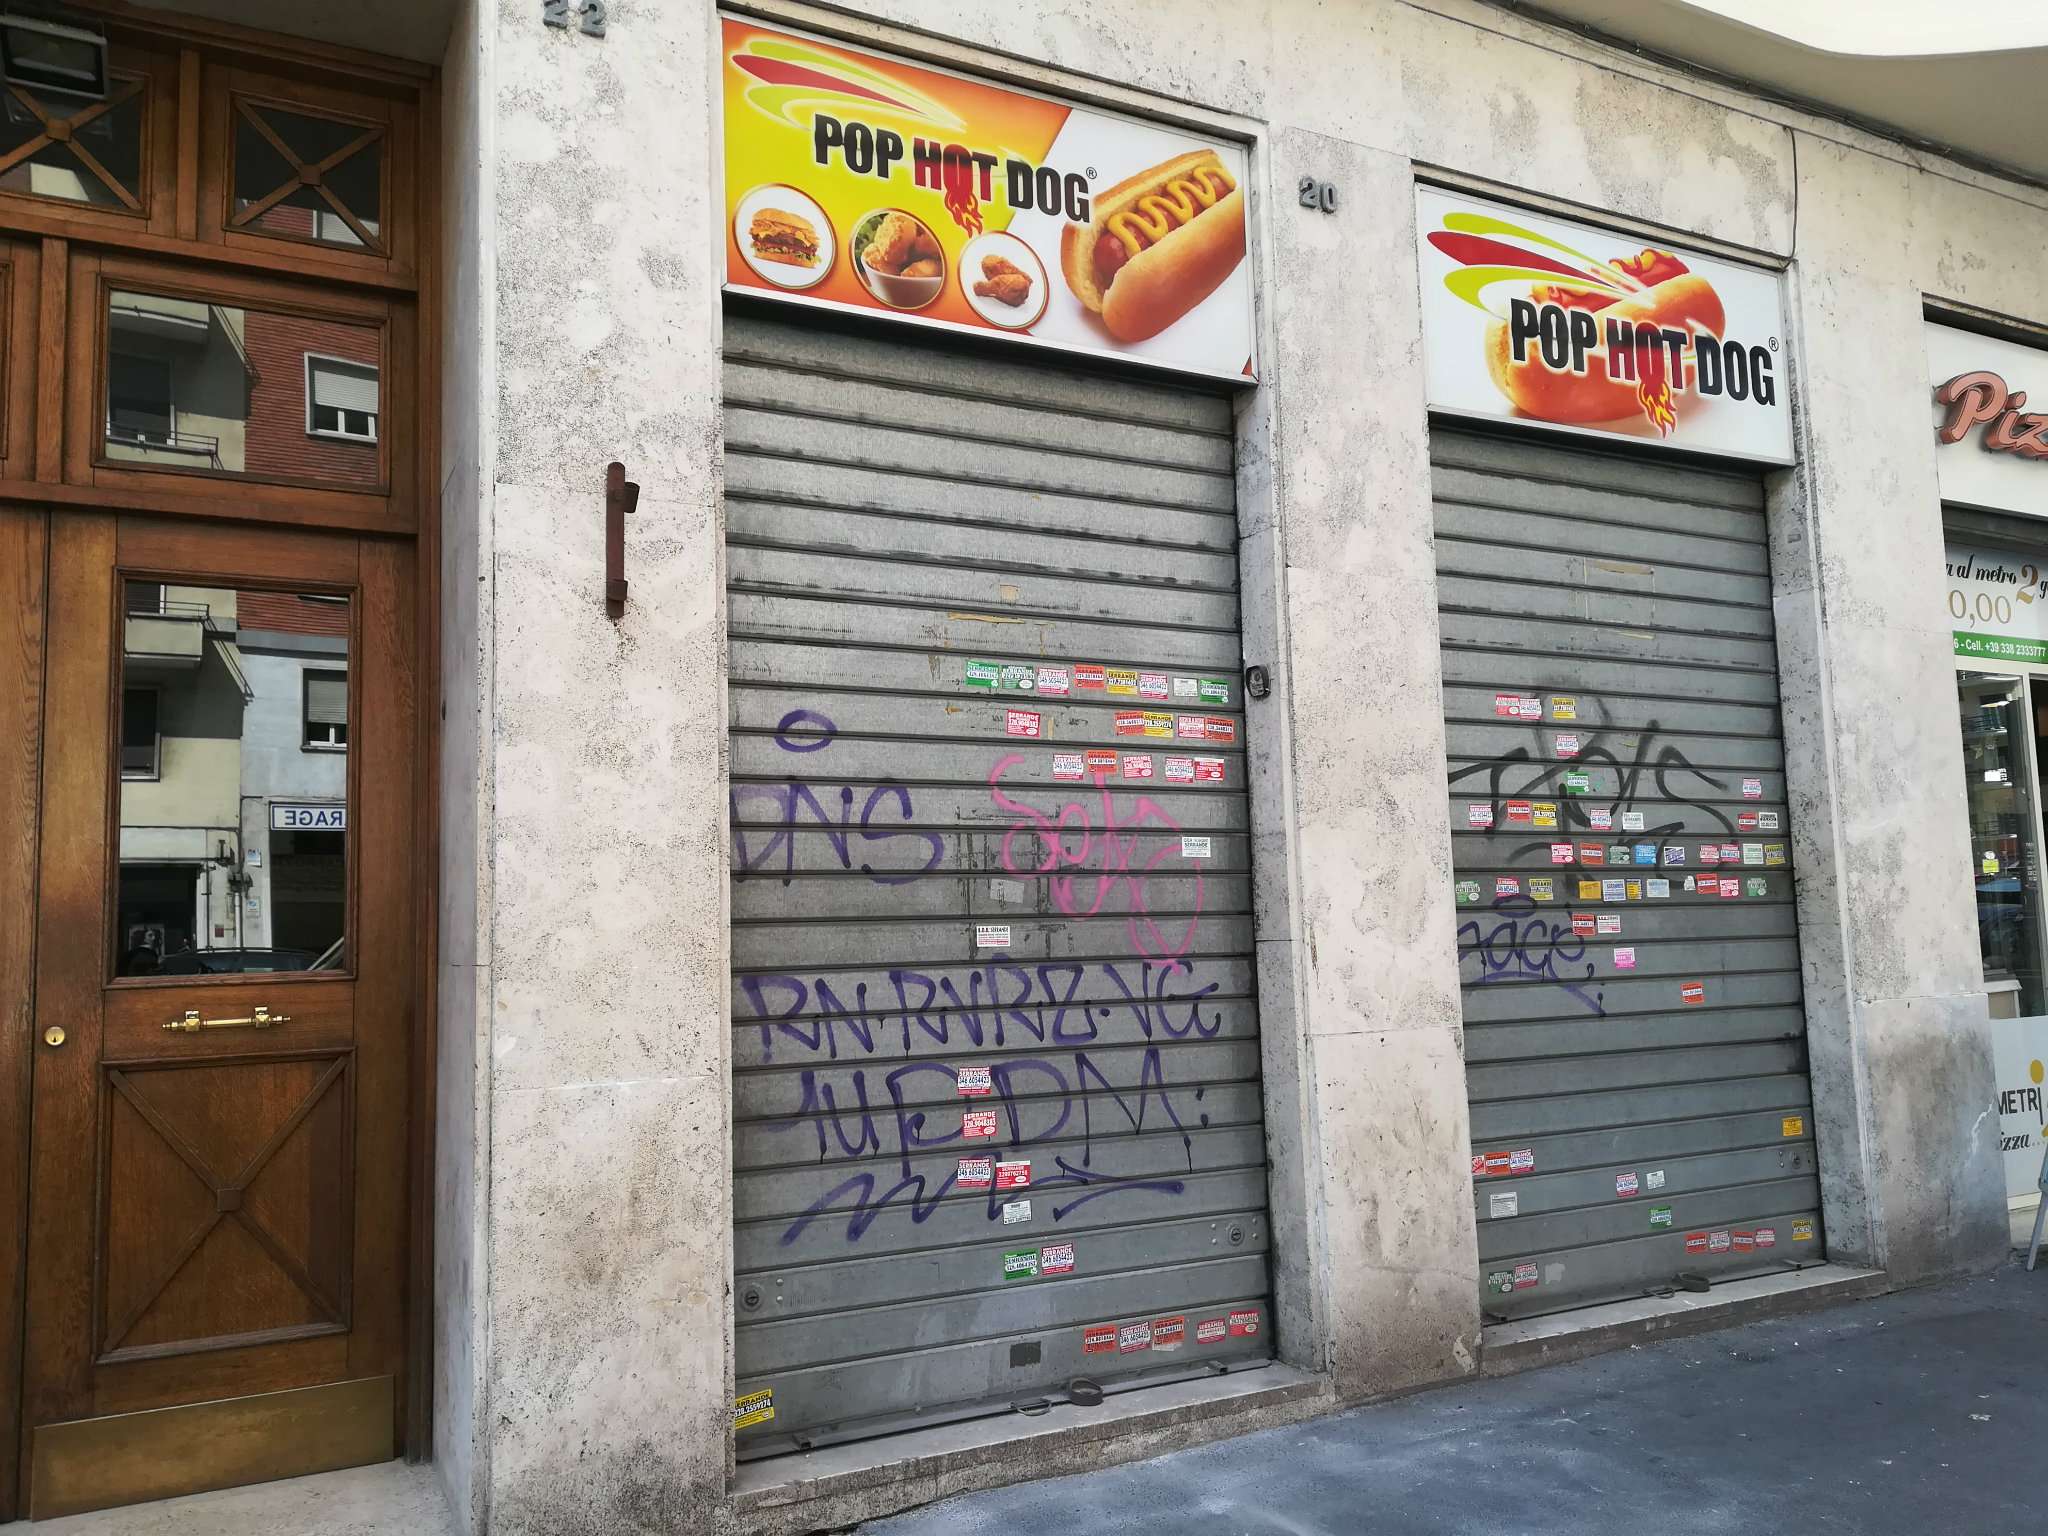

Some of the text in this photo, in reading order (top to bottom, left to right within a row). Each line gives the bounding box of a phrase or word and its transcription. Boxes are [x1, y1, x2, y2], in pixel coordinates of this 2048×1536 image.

[814, 113, 1091, 224] POP HOT DOG
[1299, 176, 1337, 214] 20
[1510, 297, 1776, 407] POP HOT DOG
[1976, 565, 2017, 585] metro
[963, 1111, 996, 1121] SERRANDE
